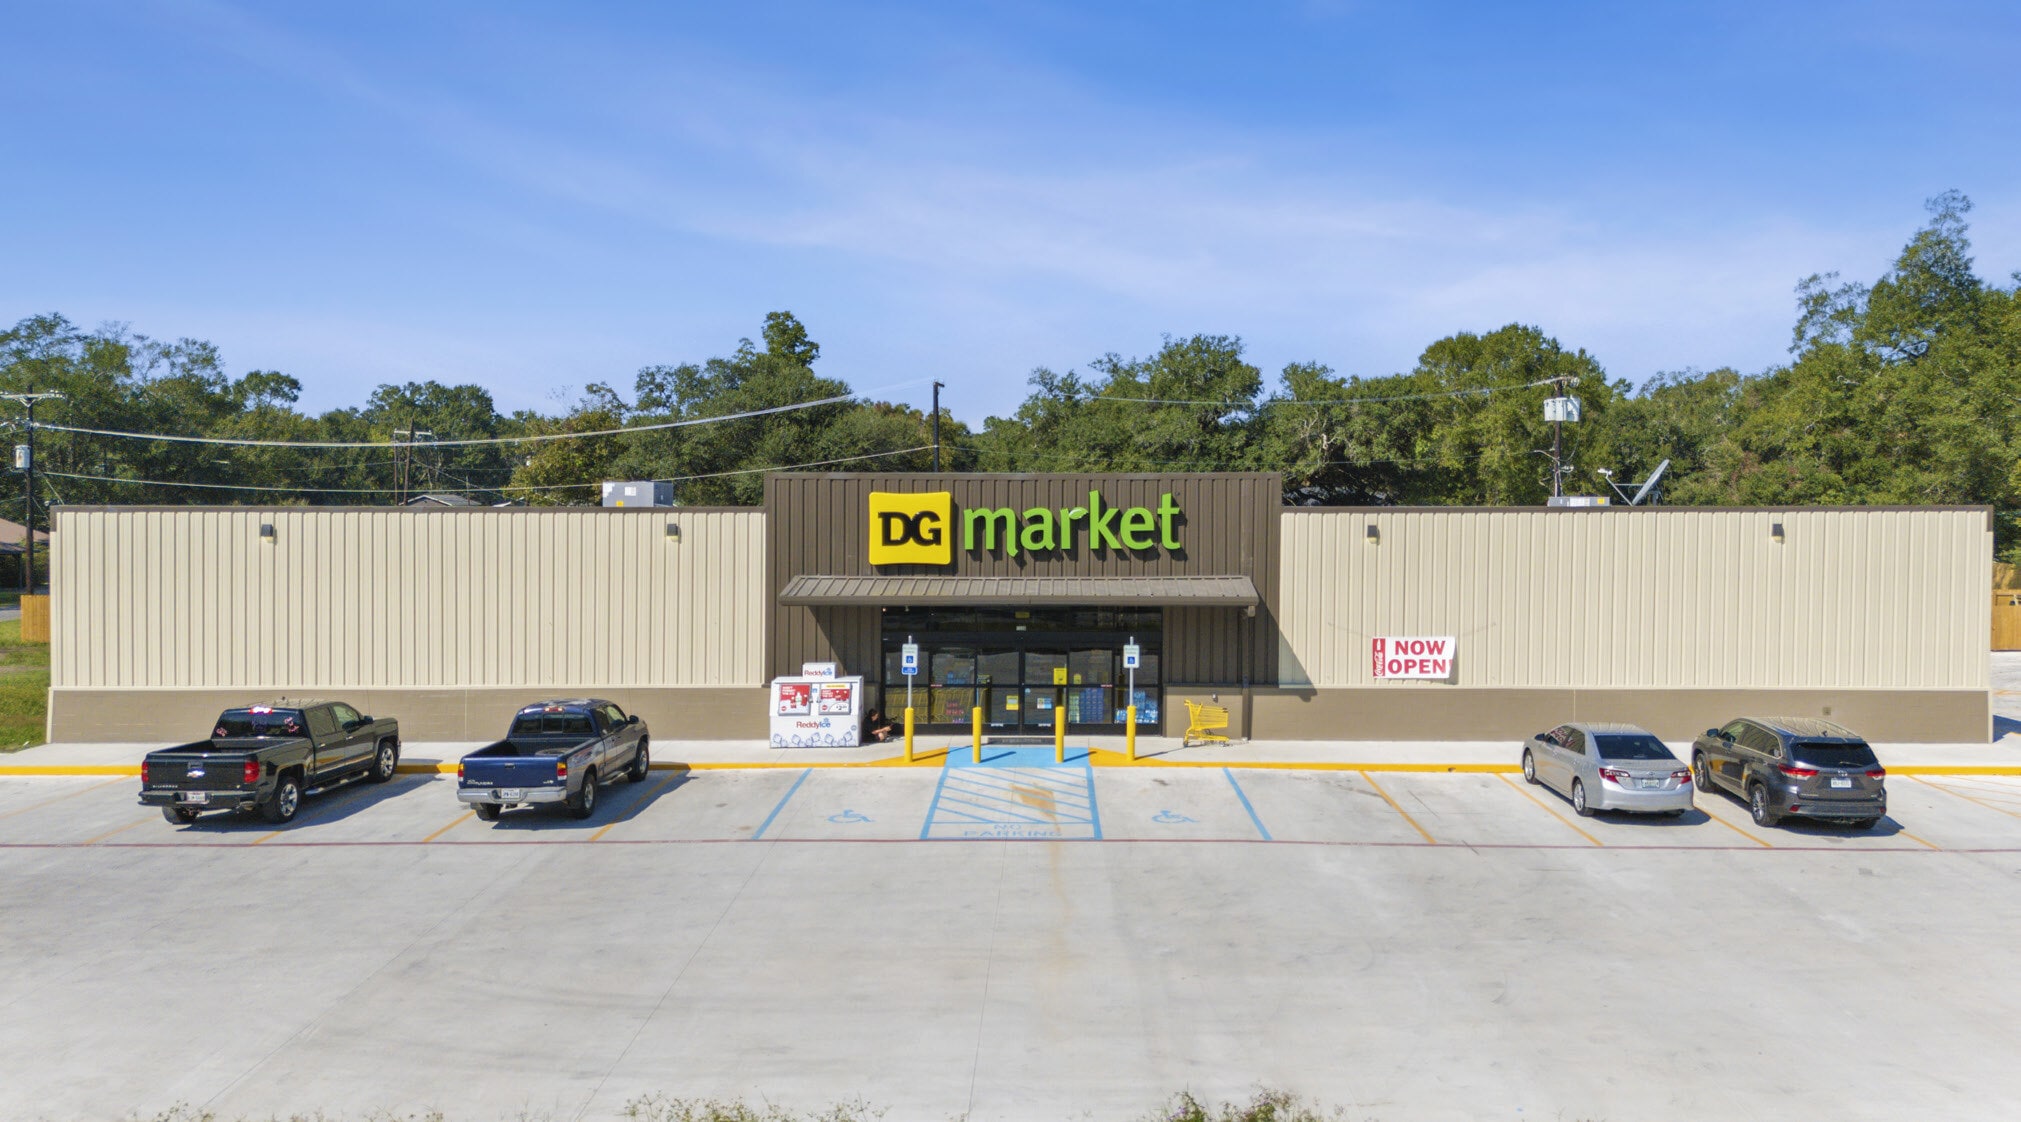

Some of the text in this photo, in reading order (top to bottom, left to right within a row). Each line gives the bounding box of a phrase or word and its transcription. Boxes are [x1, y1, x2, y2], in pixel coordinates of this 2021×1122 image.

[878, 490, 1181, 558] DG market
[1395, 640, 1446, 655] NOW
